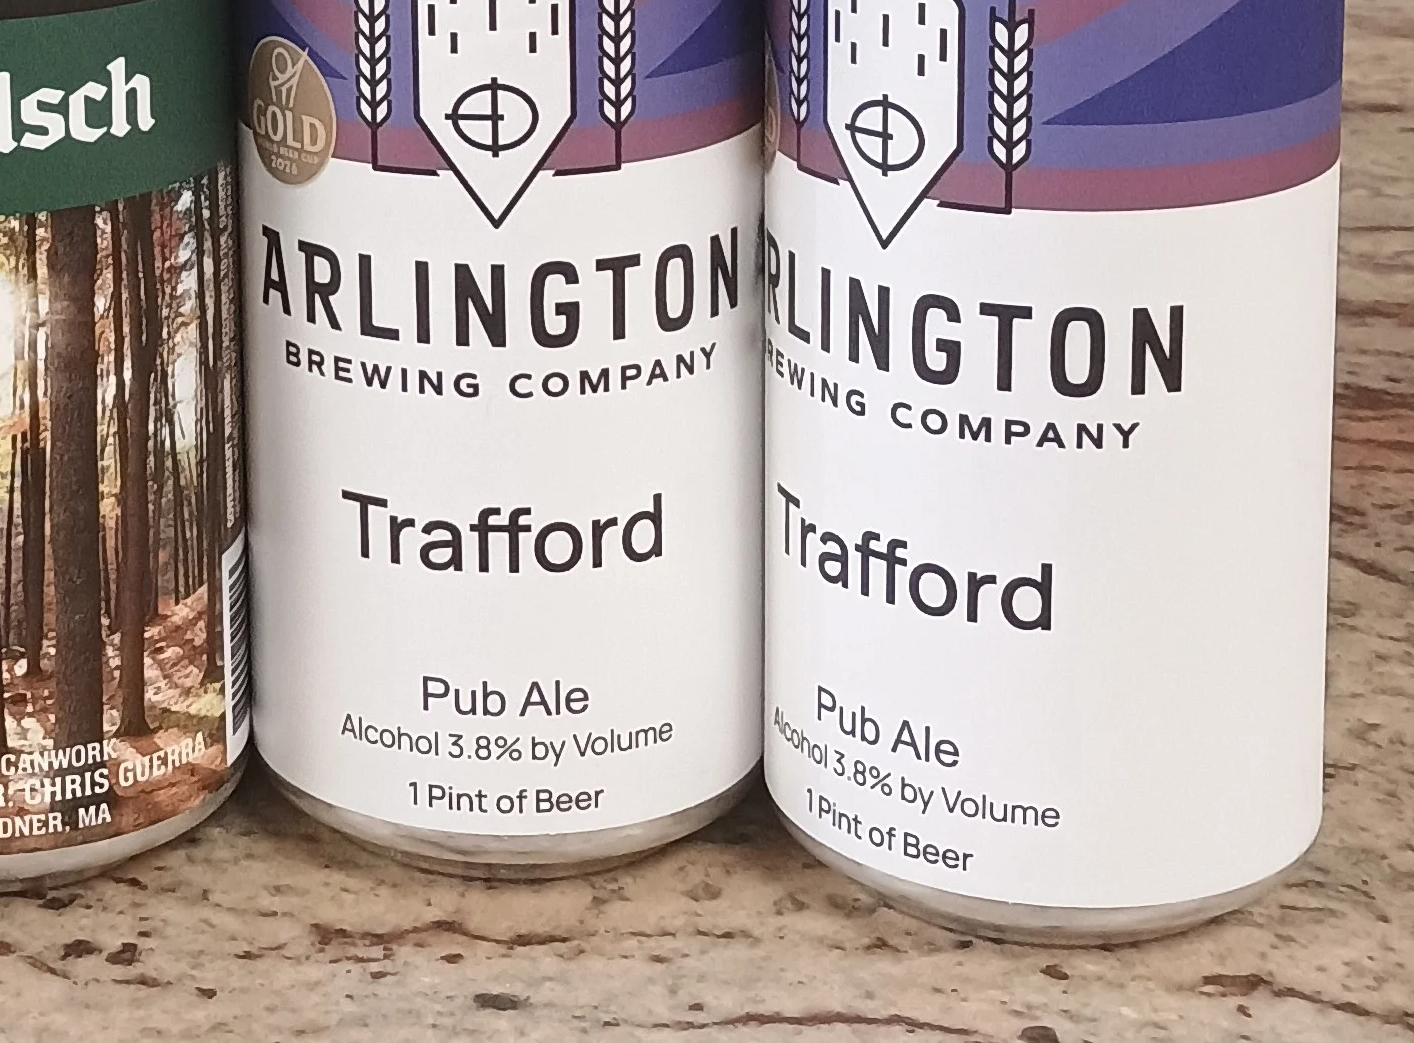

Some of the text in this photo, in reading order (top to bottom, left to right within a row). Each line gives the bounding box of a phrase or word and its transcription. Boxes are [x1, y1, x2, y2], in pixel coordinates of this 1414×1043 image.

[253, 98, 326, 153] GOLD
[262, 224, 738, 348] ARLINGTON
[766, 227, 1184, 398] RLINGTON
[285, 339, 718, 399] BREWING COMPANY
[766, 336, 1140, 450] REWING COMPANY
[341, 488, 663, 574] Trafford
[777, 481, 1053, 631] Trafford
[422, 675, 589, 717] Pub Ale
[817, 685, 961, 768] Pub Ale
[0, 738, 118, 776] CANWORK
[23, 766, 109, 805] CHRIS
[118, 731, 208, 788] GUERRA
[341, 713, 674, 767] Alcohol 3.8% by Volume
[773, 706, 1061, 828] Alcohol 3.8% by Volume
[78, 803, 112, 826] MA
[408, 781, 605, 814] 1 Pint of Beer
[806, 787, 974, 872] 1 Pint of Beer
